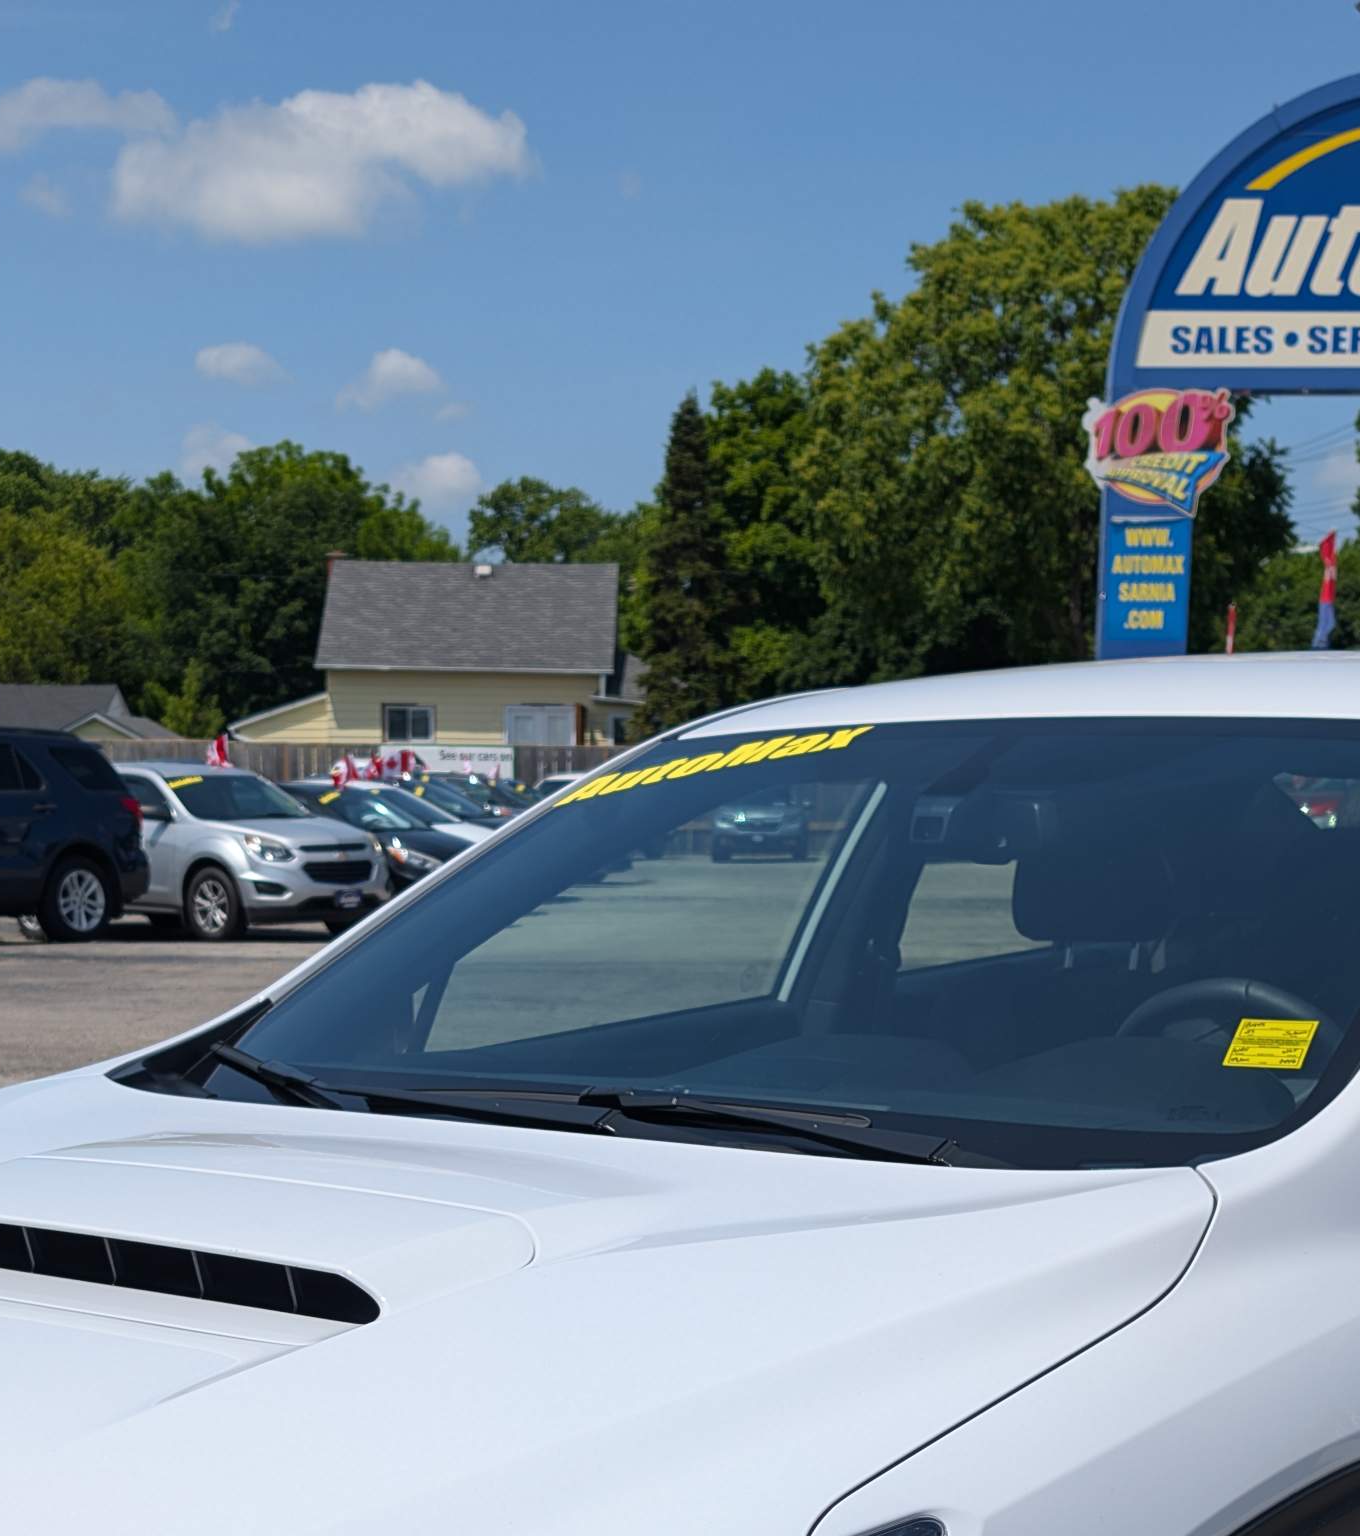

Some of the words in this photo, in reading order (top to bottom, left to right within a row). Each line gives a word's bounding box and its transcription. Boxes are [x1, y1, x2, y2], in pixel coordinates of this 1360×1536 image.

[1170, 325, 1275, 355] SALES
[1094, 388, 1230, 460] 100%
[1112, 555, 1185, 574] AUTOMAX
[1119, 582, 1176, 602] SARNIA
[439, 749, 455, 760] See
[478, 752, 497, 761] cars
